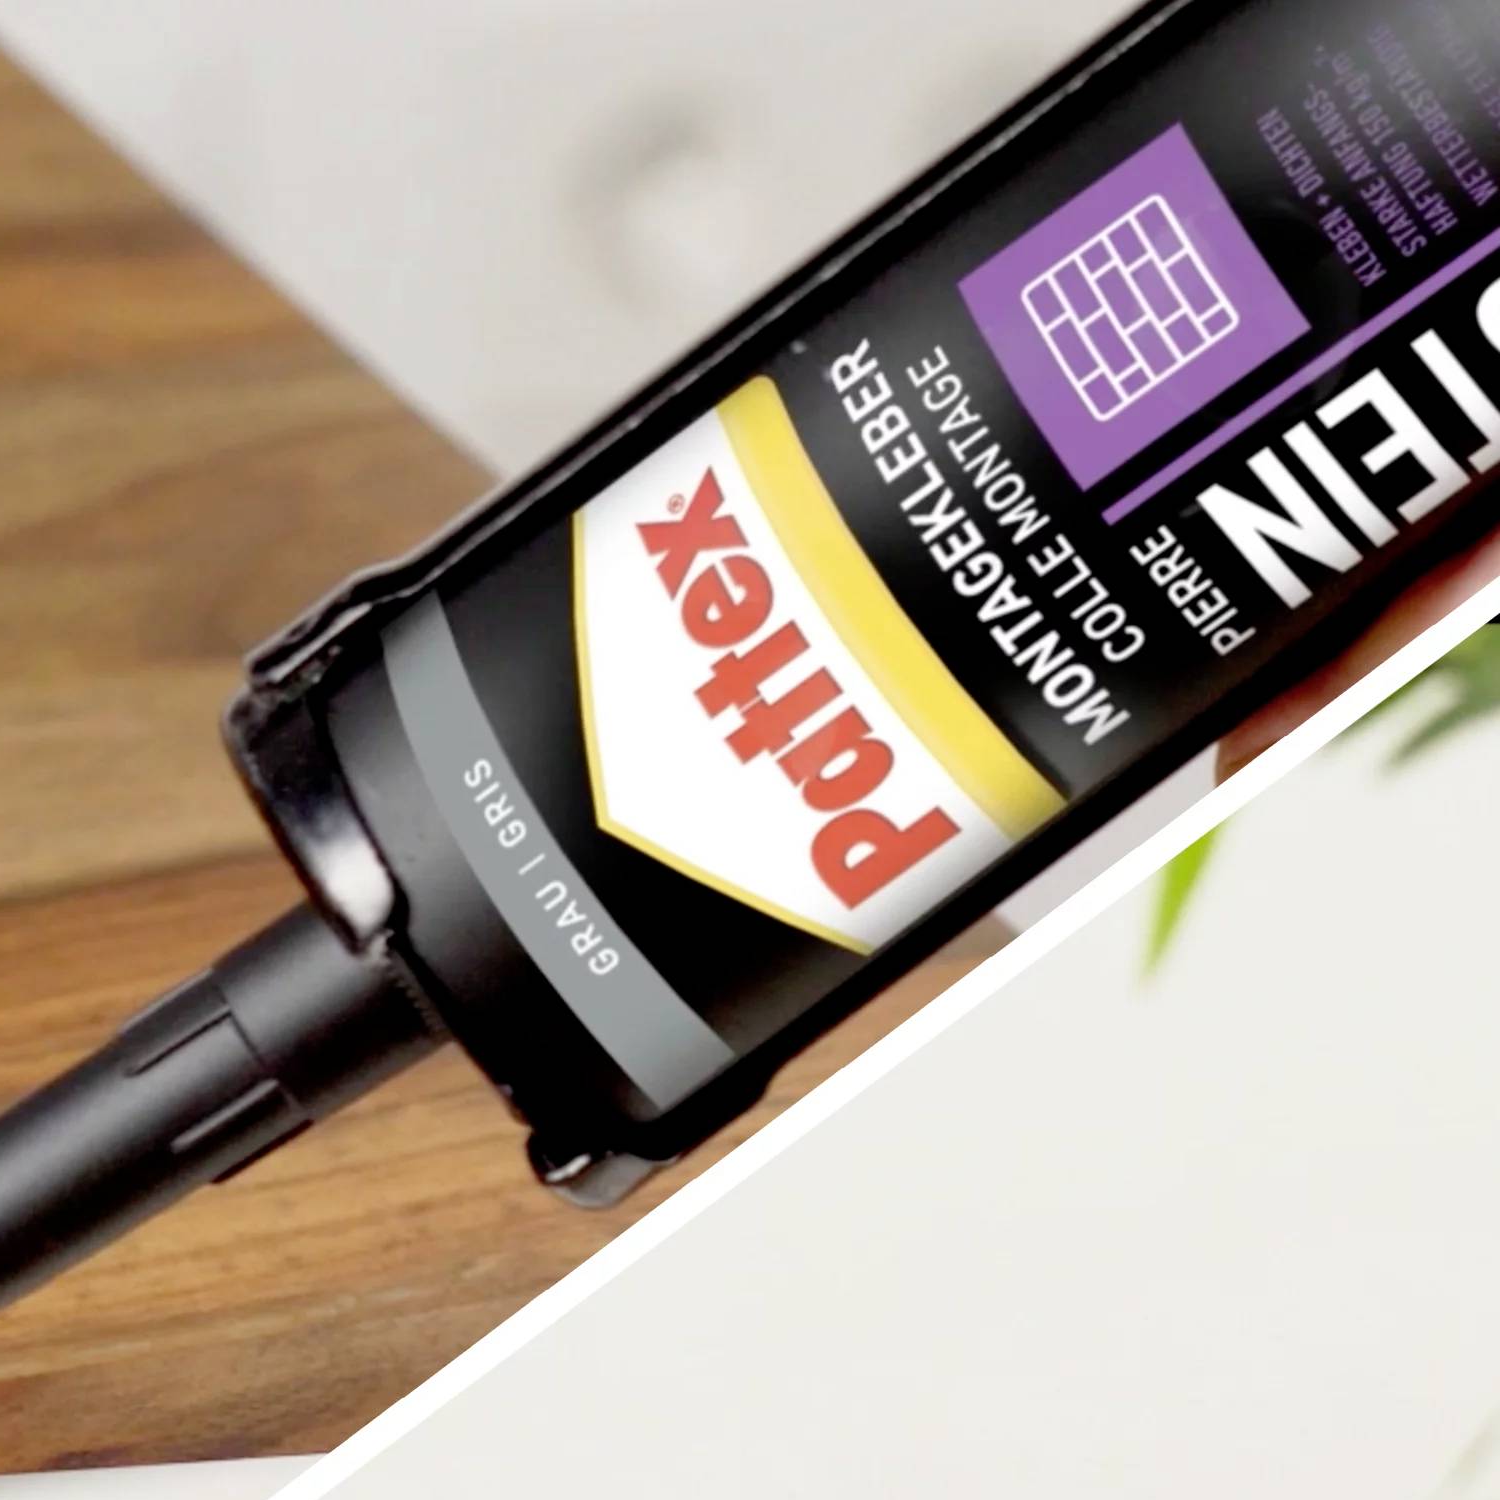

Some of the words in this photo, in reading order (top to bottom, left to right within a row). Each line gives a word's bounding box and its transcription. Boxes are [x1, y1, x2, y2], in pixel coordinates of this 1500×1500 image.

[1256, 106, 1325, 198] DICHTEN
[1357, 103, 1396, 147] 150
[1359, 175, 1428, 258] STARKE
[1381, 141, 1459, 236] HAFTUNG
[1318, 205, 1388, 288] KLEBEN
[905, 345, 1051, 545] MONTAGE
[1196, 274, 1500, 610] TEIN
[829, 338, 1131, 747] MONTAGEKLEBER
[1128, 524, 1256, 657] PIERRE
[1026, 533, 1146, 663] COLLE
[634, 465, 962, 911] Pattex
[463, 758, 527, 849] GRIS
[534, 880, 620, 976] GRAU
